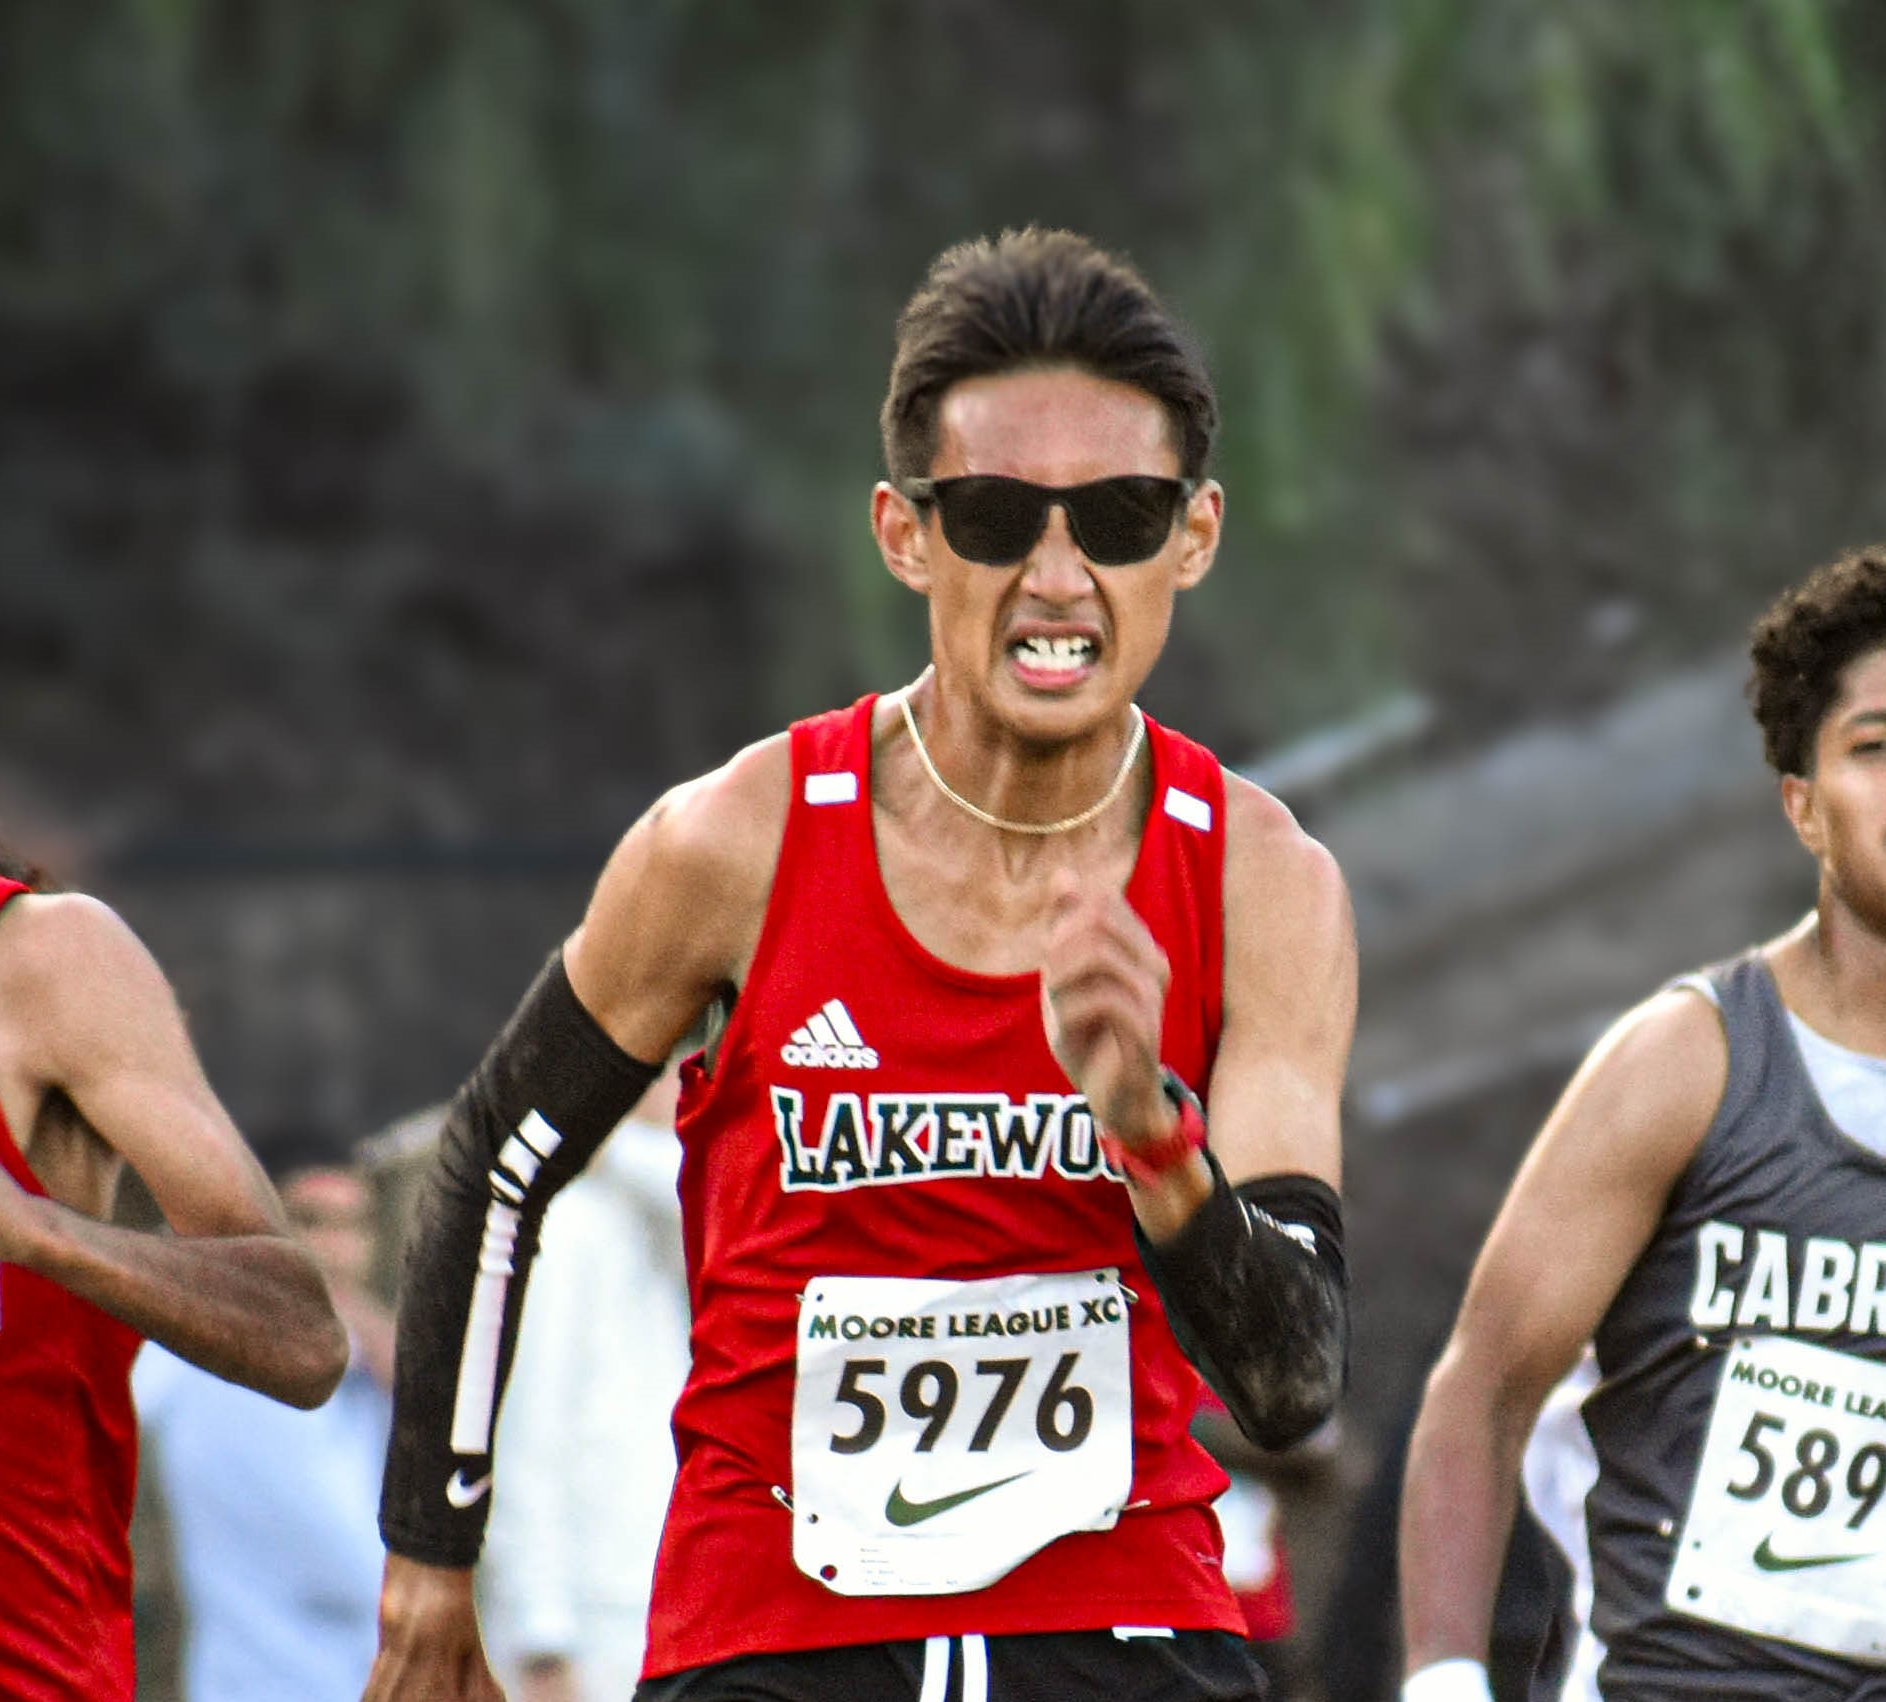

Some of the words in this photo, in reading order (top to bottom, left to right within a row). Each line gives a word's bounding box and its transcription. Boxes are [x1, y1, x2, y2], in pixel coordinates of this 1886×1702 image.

[780, 1039, 880, 1069] adidas
[769, 1085, 1127, 1192] LAKEWO
[807, 1313, 936, 1341] MOORE
[948, 1304, 1071, 1337] LEAGUE
[1080, 1296, 1122, 1326] XC
[829, 1351, 1095, 1455] 5976
[1730, 1360, 1836, 1407] MOORE
